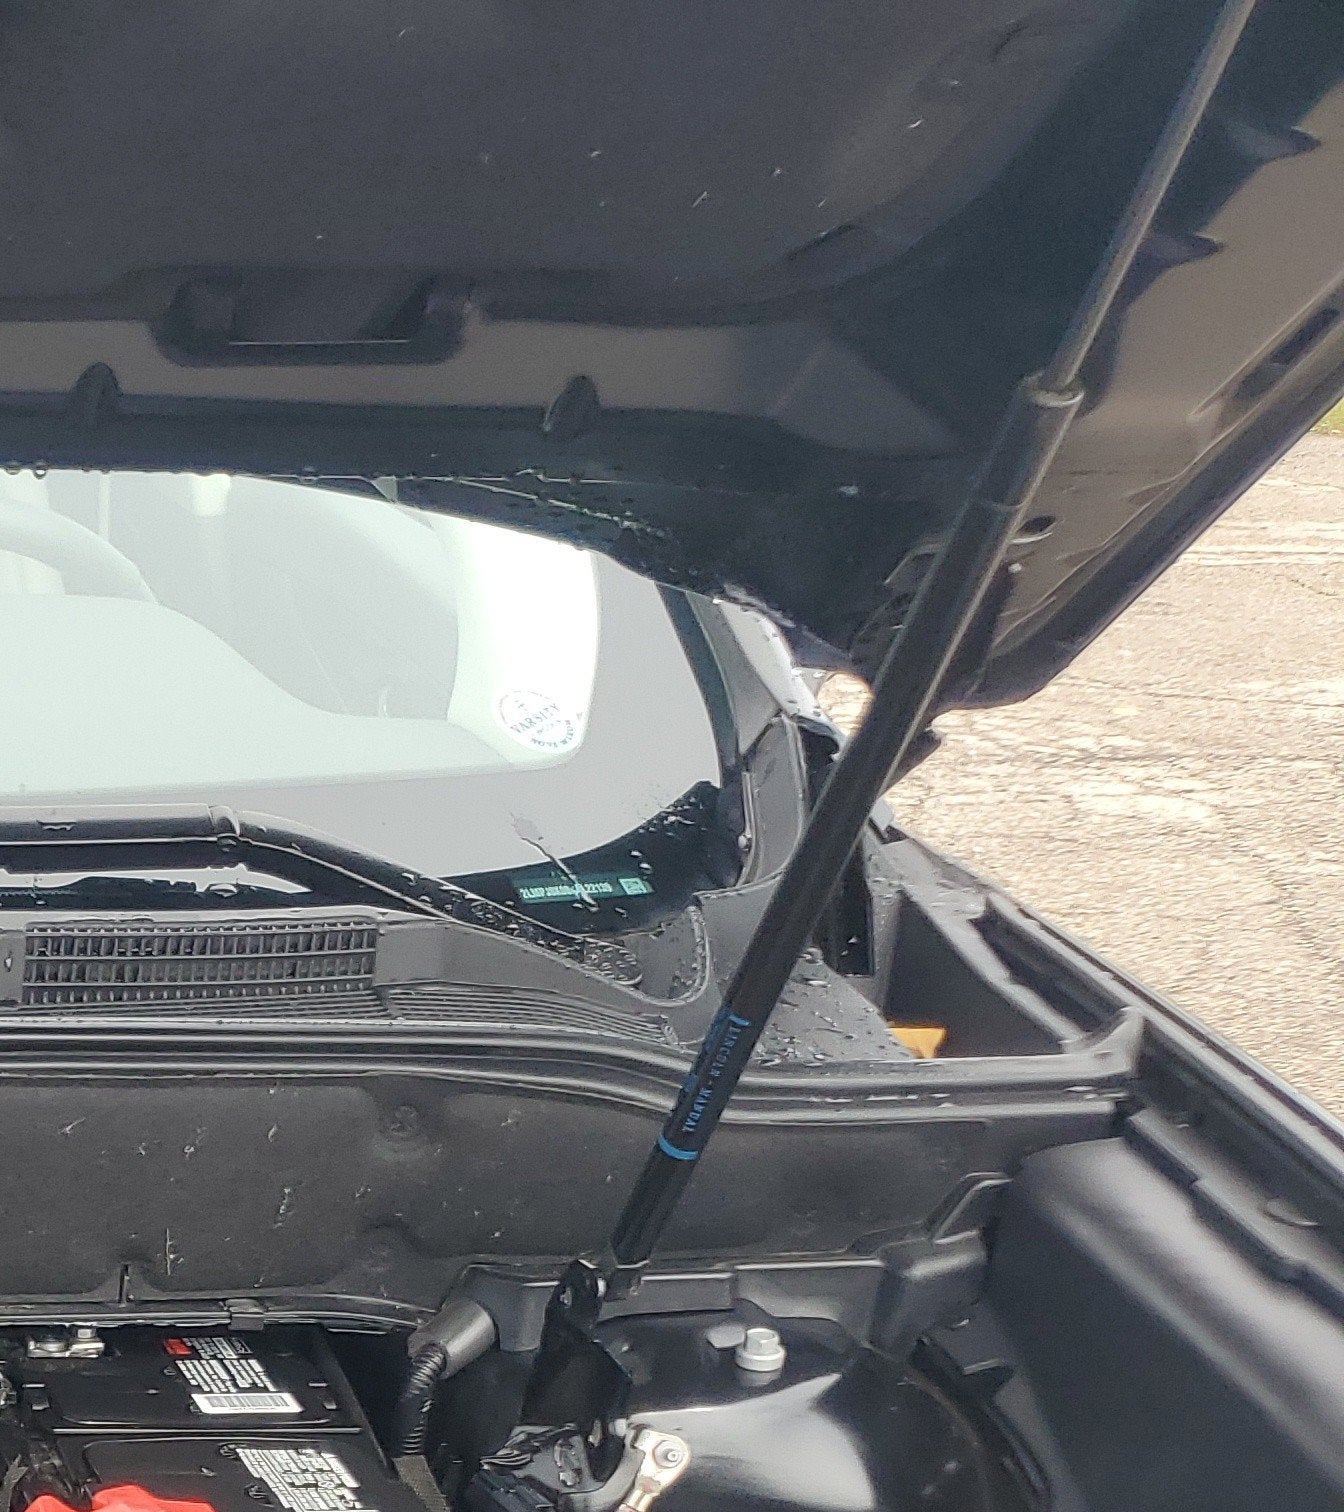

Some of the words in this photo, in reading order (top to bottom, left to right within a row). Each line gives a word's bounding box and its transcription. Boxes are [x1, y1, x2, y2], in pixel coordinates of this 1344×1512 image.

[510, 703, 560, 734] VARSITY
[710, 1026, 741, 1077] LINCOLN
[682, 1087, 713, 1132] MANUAL
